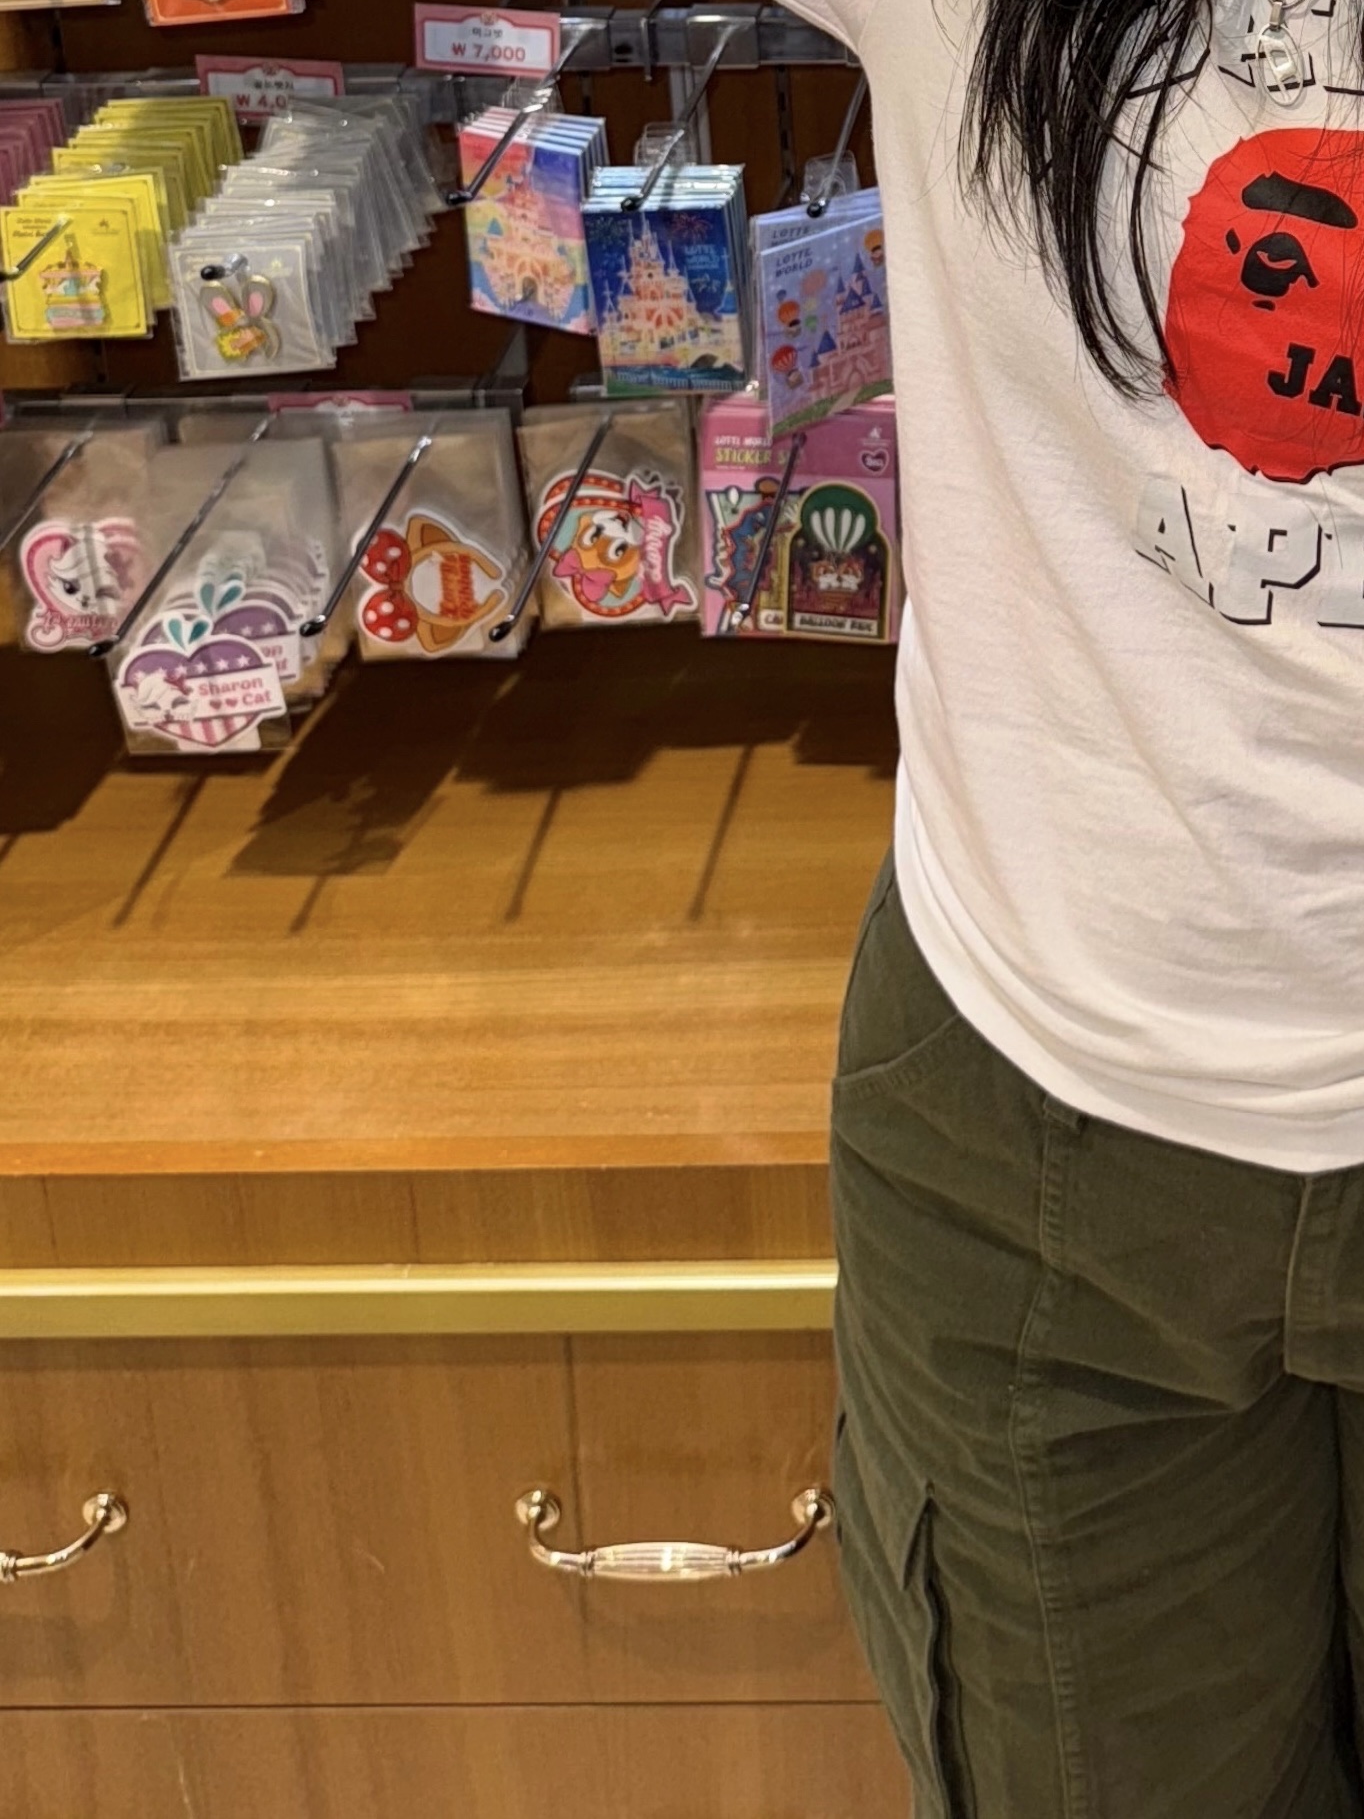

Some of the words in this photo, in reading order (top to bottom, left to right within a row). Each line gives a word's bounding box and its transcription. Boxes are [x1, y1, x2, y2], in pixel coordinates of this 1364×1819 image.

[473, 43, 526, 62] 7,000
[257, 94, 287, 110] 4,0
[199, 677, 263, 696] Sharon
[242, 691, 272, 707] Cat
